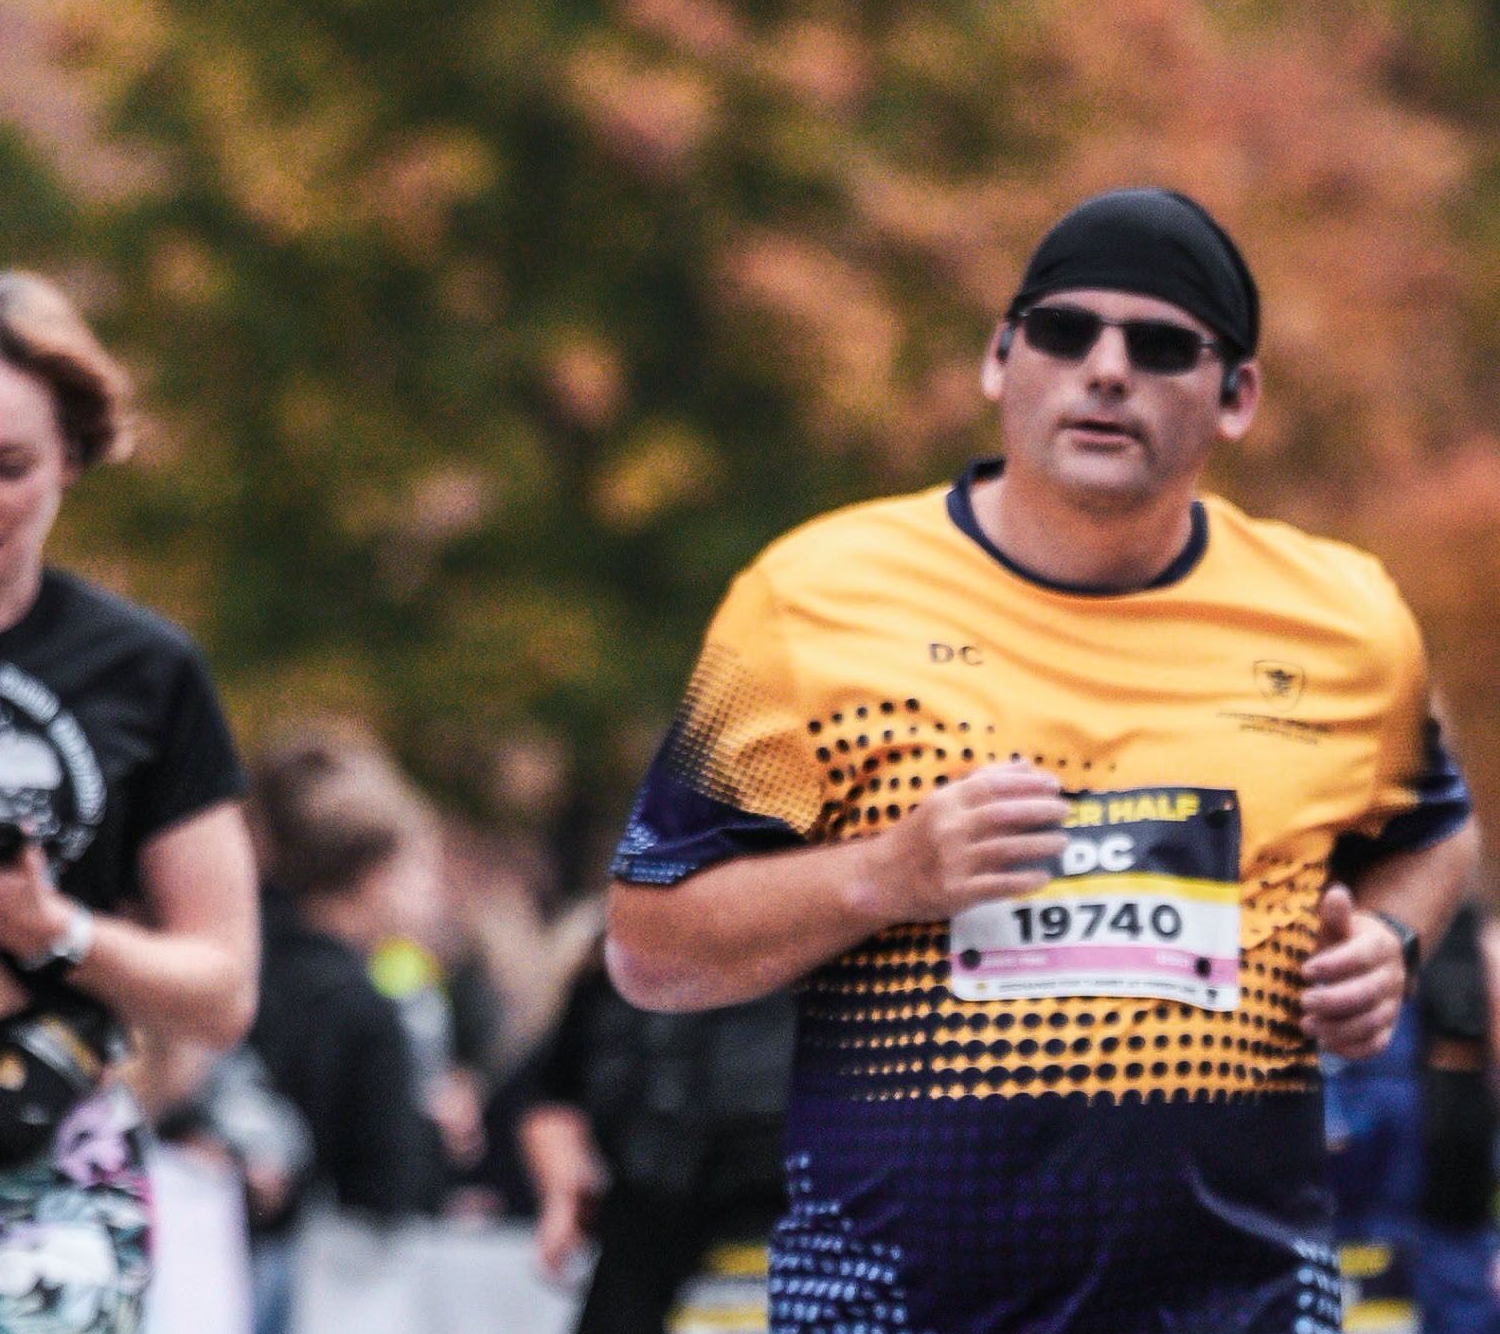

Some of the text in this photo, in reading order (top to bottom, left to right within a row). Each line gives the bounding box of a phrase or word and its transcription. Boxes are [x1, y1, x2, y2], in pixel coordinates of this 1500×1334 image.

[929, 643, 984, 666] DC
[1107, 794, 1198, 825] HALF
[1062, 835, 1136, 876] DC
[1012, 902, 1183, 944] 19740
